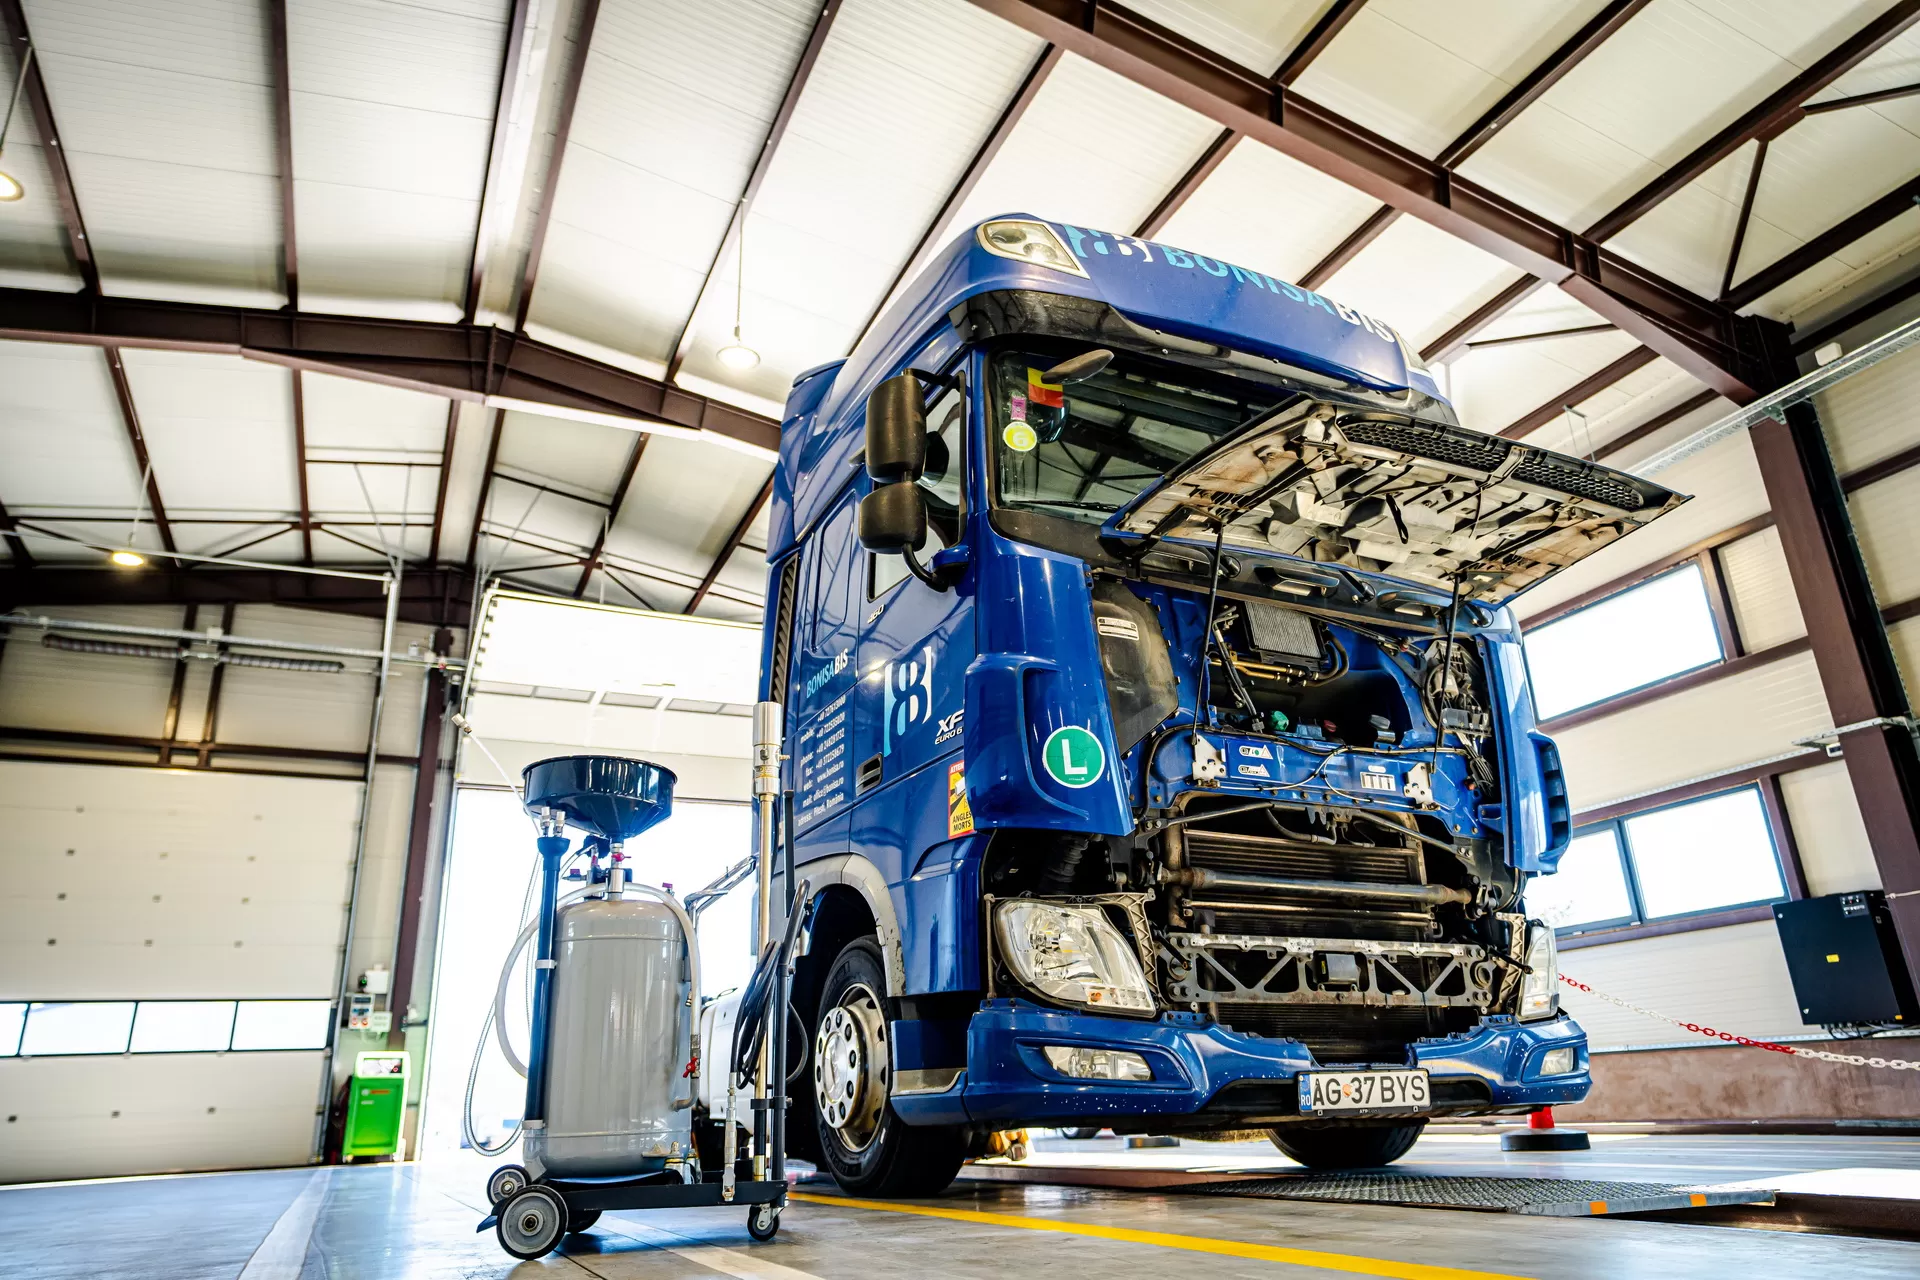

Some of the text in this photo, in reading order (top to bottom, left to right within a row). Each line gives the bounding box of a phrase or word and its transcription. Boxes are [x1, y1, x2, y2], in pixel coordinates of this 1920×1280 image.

[806, 648, 849, 699] BONISABIS
[937, 708, 964, 736] XF
[935, 730, 956, 745] EURO
[1061, 739, 1088, 775] L
[952, 811, 972, 824] ANGLES
[953, 820, 971, 832] MORTS
[1301, 1075, 1425, 1106] RO AG 37 BYS
